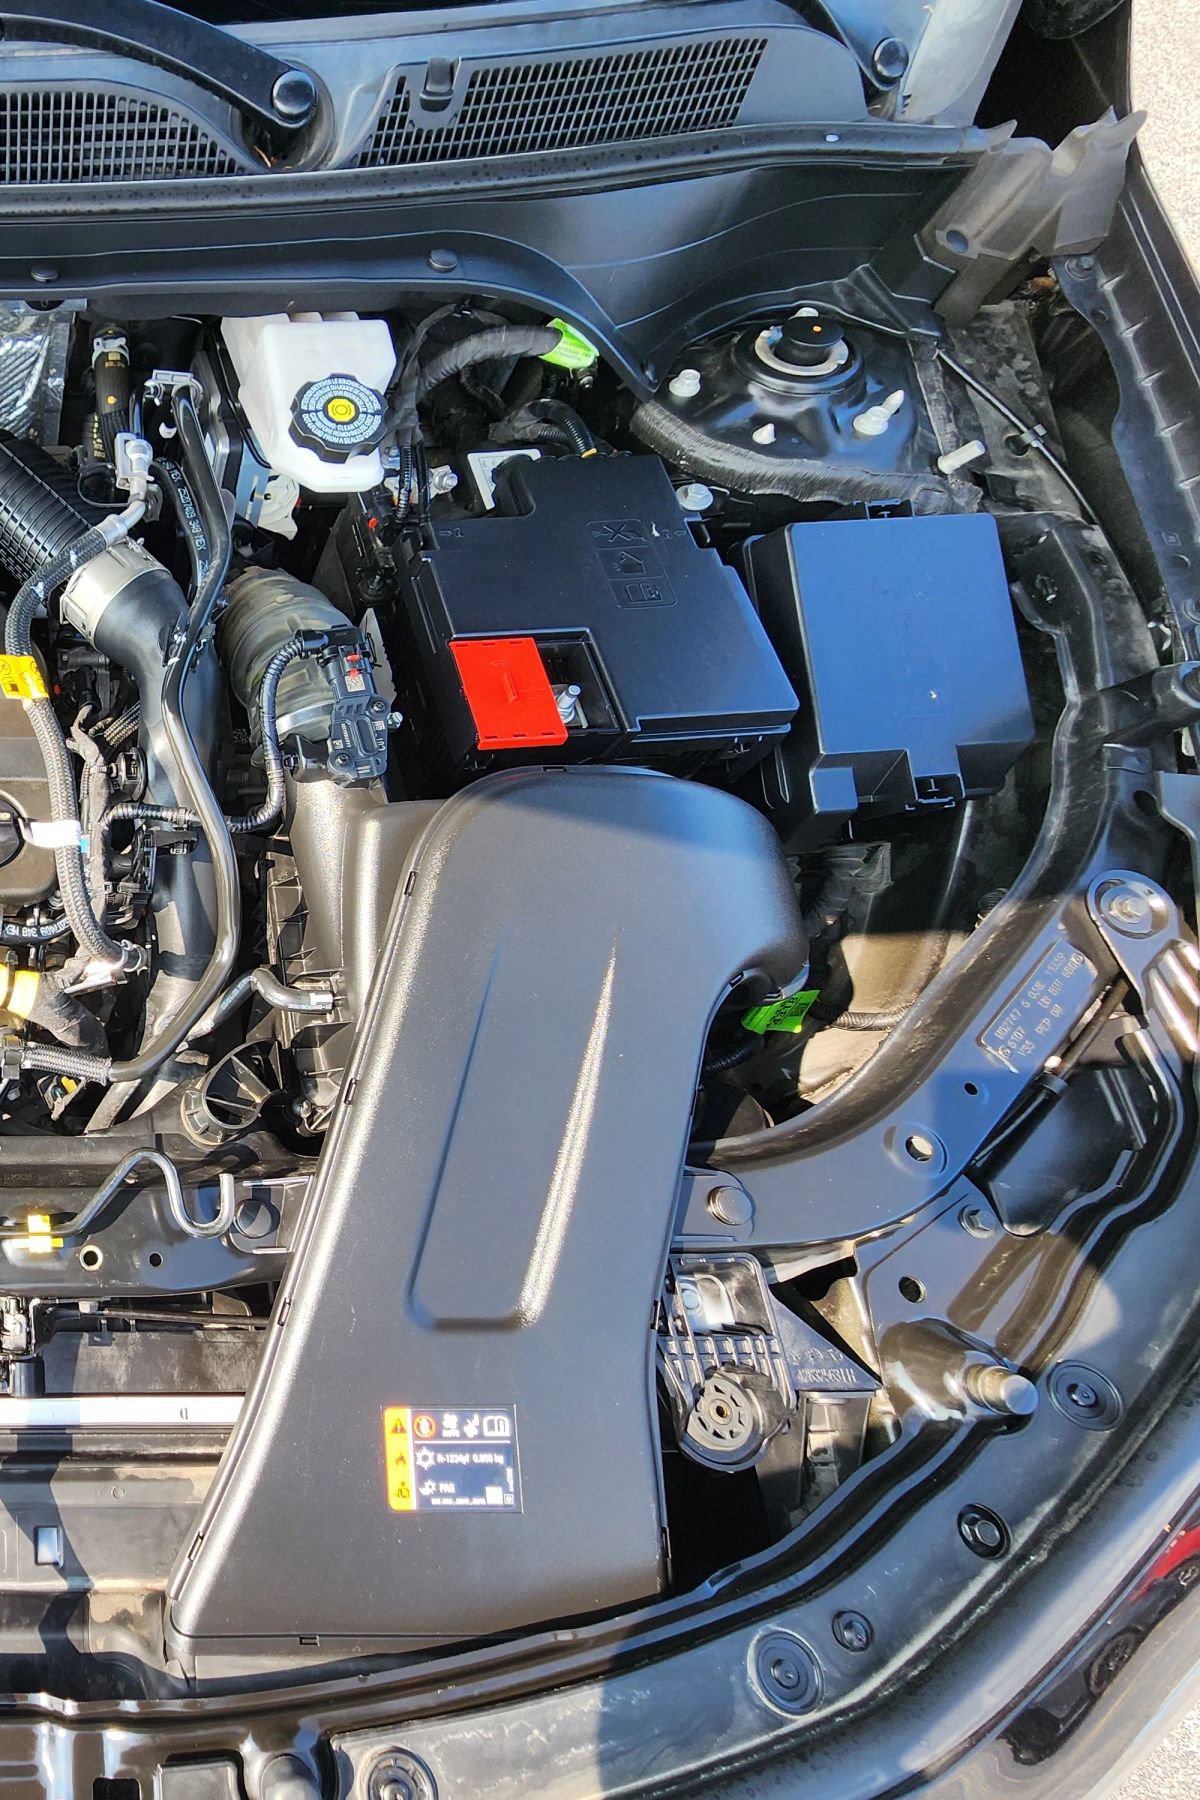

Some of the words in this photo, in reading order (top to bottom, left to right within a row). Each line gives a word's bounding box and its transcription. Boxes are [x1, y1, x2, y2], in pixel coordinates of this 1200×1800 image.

[194, 534, 207, 551] MEX
[4, 926, 20, 937] MEX
[22, 927, 38, 938] 348
[40, 917, 69, 938] 5207409
[439, 1482, 456, 1493] PAG
